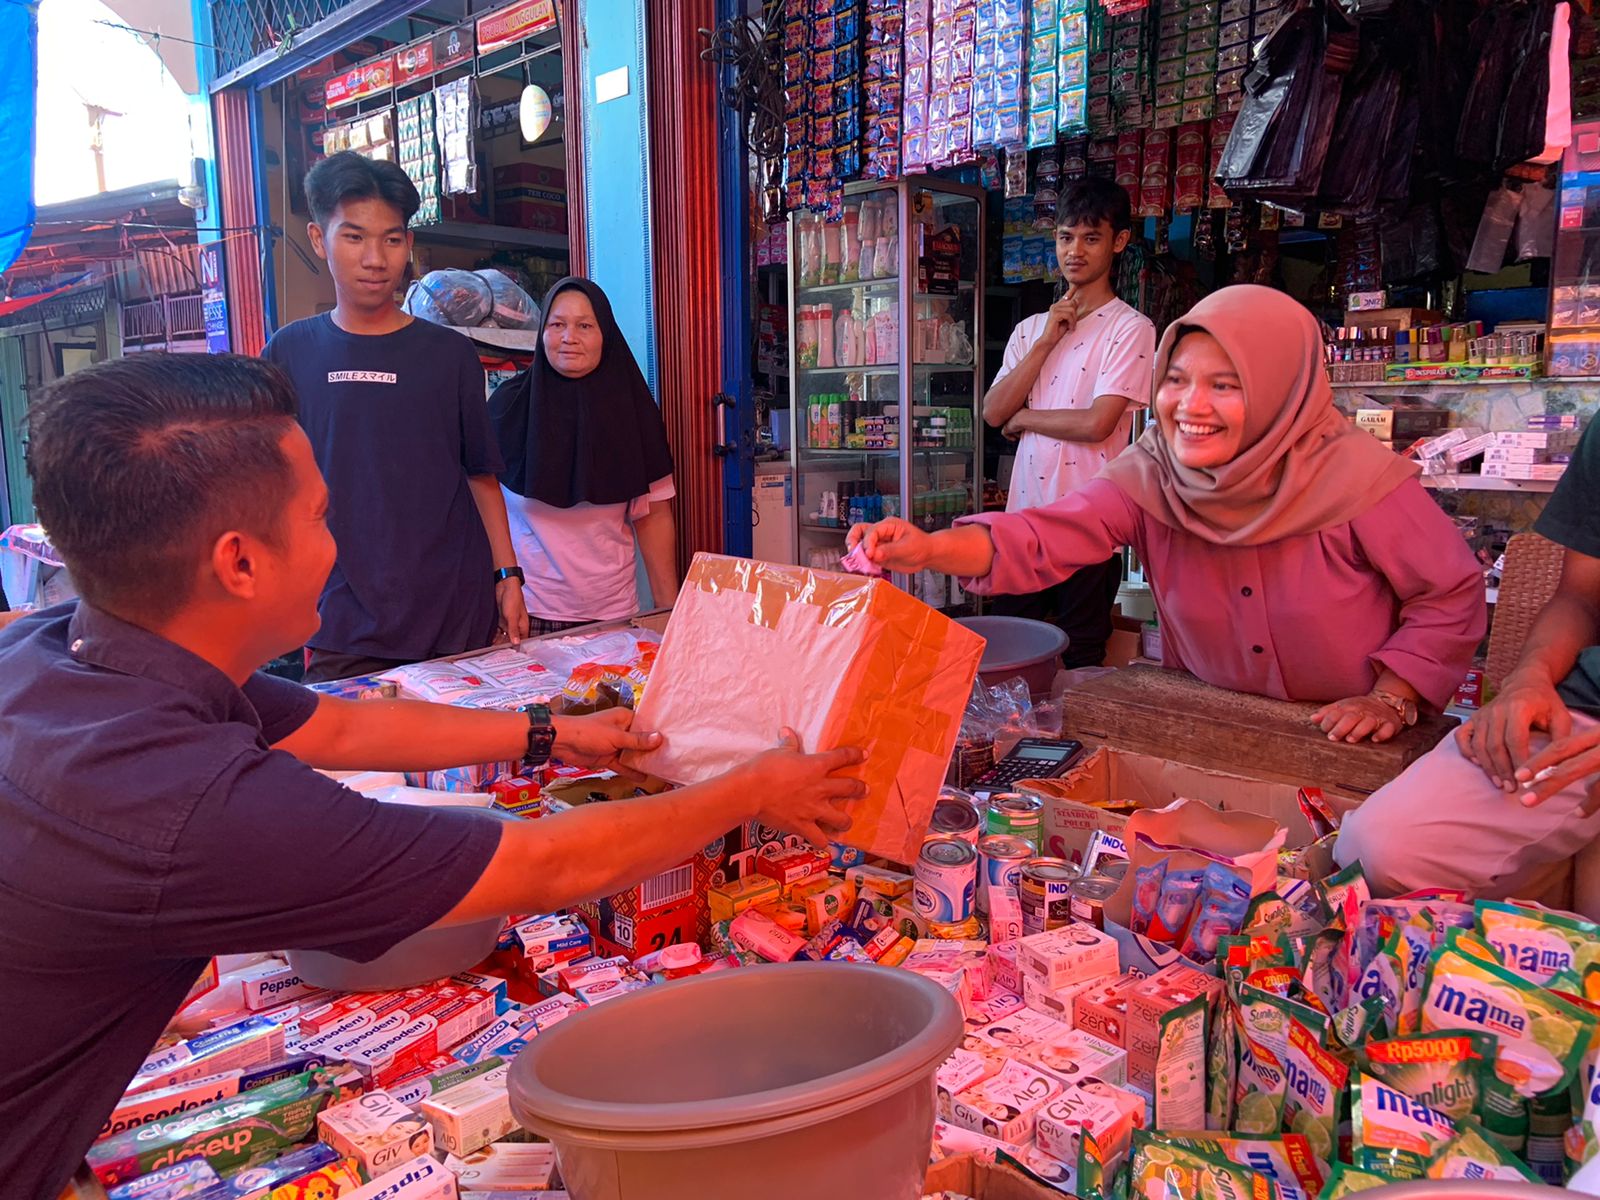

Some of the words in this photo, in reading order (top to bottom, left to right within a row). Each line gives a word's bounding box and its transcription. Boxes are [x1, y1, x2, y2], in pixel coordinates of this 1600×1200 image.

[511, 3, 548, 29] UNGGULAN
[1056, 809, 1096, 820] STANDING
[1063, 819, 1091, 828] POUCH
[569, 939, 582, 947] Care
[616, 924, 631, 941] 10
[650, 927, 683, 951] 24
[583, 960, 616, 972] NUVO
[1264, 974, 1290, 987] 2000
[528, 1000, 560, 1018] NUVO
[988, 993, 1020, 1012] Giv
[1434, 984, 1525, 1031] mama
[1079, 1011, 1107, 1033] zen
[1249, 1009, 1283, 1023] Sunlight
[299, 1014, 365, 1052] Pepsodent
[333, 1015, 398, 1053] Pepsodent
[361, 1021, 427, 1058] Pepsodent
[473, 1020, 508, 1048] NUVO
[1387, 1039, 1459, 1062] Rp5000
[1015, 1077, 1050, 1106] Giv
[360, 1091, 399, 1120] Giv
[954, 1104, 978, 1124] Giv
[1047, 1093, 1085, 1121] Giv
[137, 1102, 247, 1141] closeup
[1038, 1119, 1064, 1138] Giv
[319, 1125, 337, 1145] Giv
[440, 1132, 457, 1151] Giv
[152, 1128, 253, 1171] closeup
[372, 1144, 402, 1167] Giv
